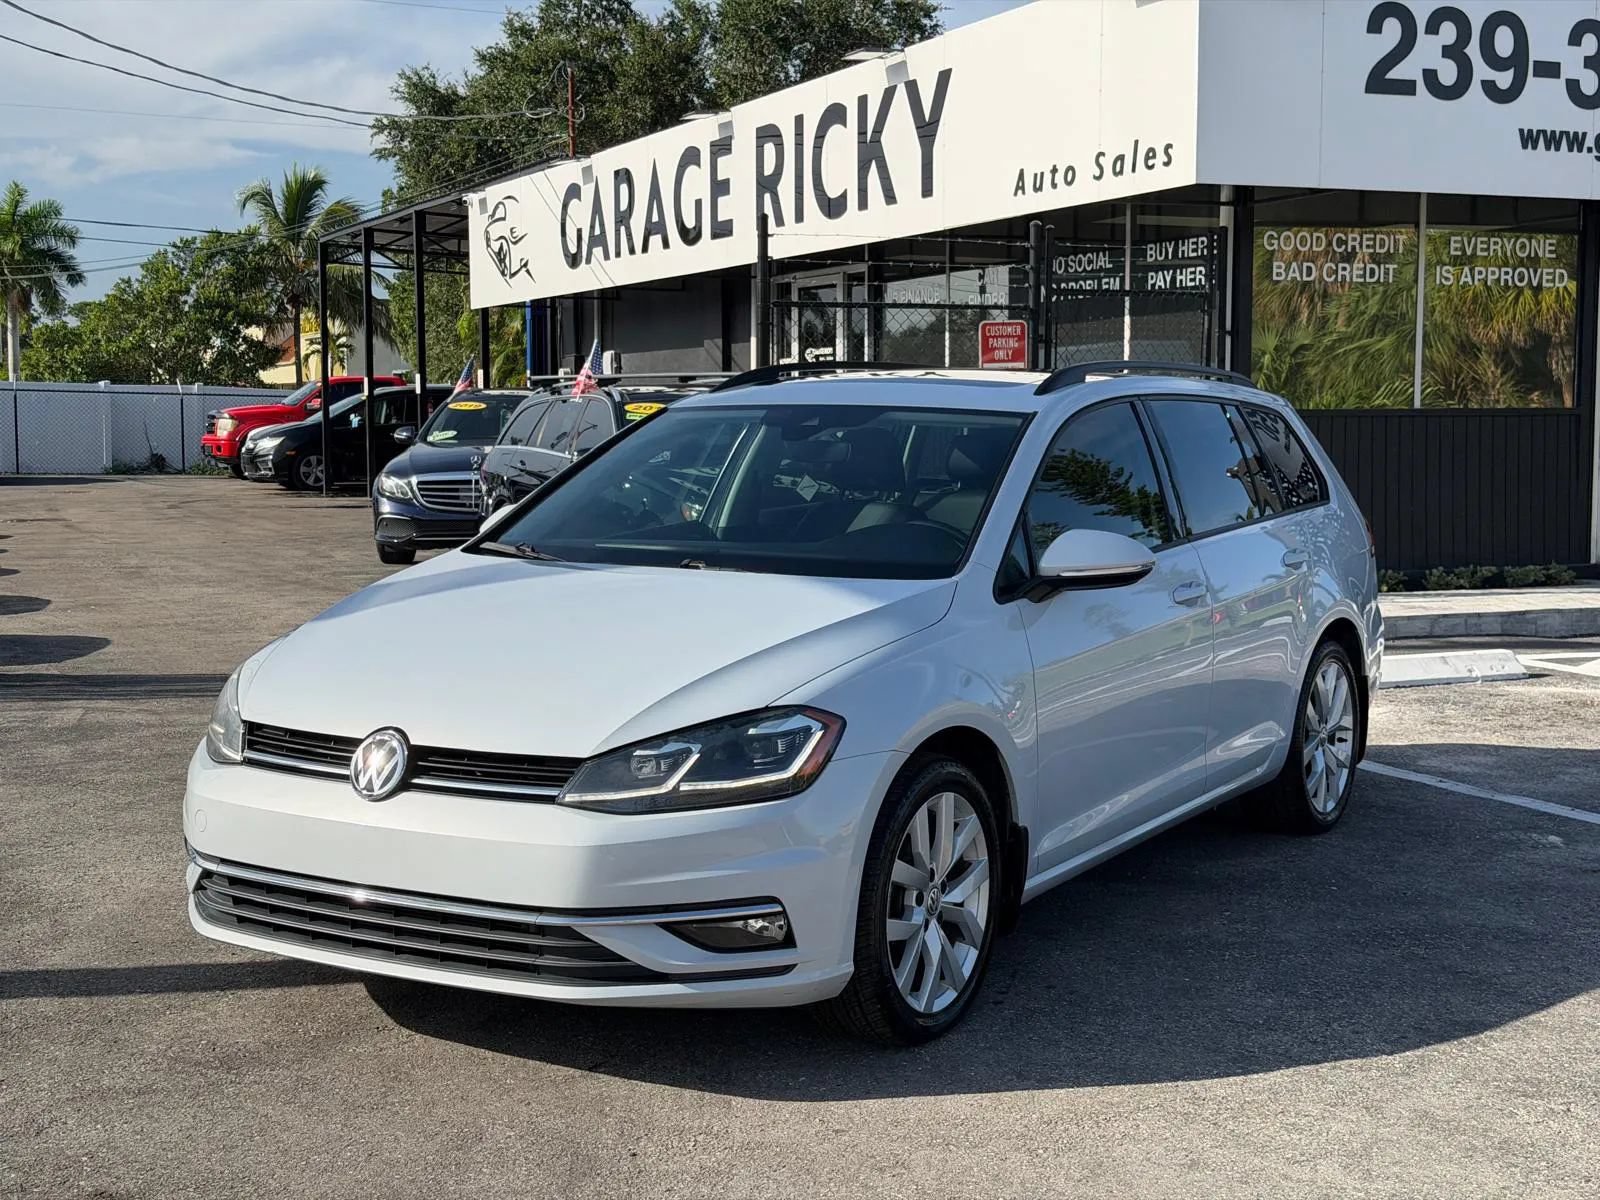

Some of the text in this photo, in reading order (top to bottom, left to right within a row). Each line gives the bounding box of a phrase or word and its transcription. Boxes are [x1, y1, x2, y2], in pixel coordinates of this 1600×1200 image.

[1364, 1, 1600, 110] 239-3
[560, 68, 953, 270] GARAGE RICKY
[1013, 139, 1174, 197] Auto Sales
[1146, 241, 1175, 262] BUY
[1263, 231, 1407, 254] GOOD CREDIT
[1450, 236, 1557, 258] EVERYONE
[1067, 250, 1113, 273] SOCIAL
[1272, 262, 1398, 283] BAD CREDIT
[1147, 269, 1173, 290] PAY
[1435, 266, 1568, 288] IS APPROVED
[985, 325, 1021, 336] CUSTOMER
[988, 337, 1019, 348] PARKING
[994, 349, 1013, 361] ONLY
